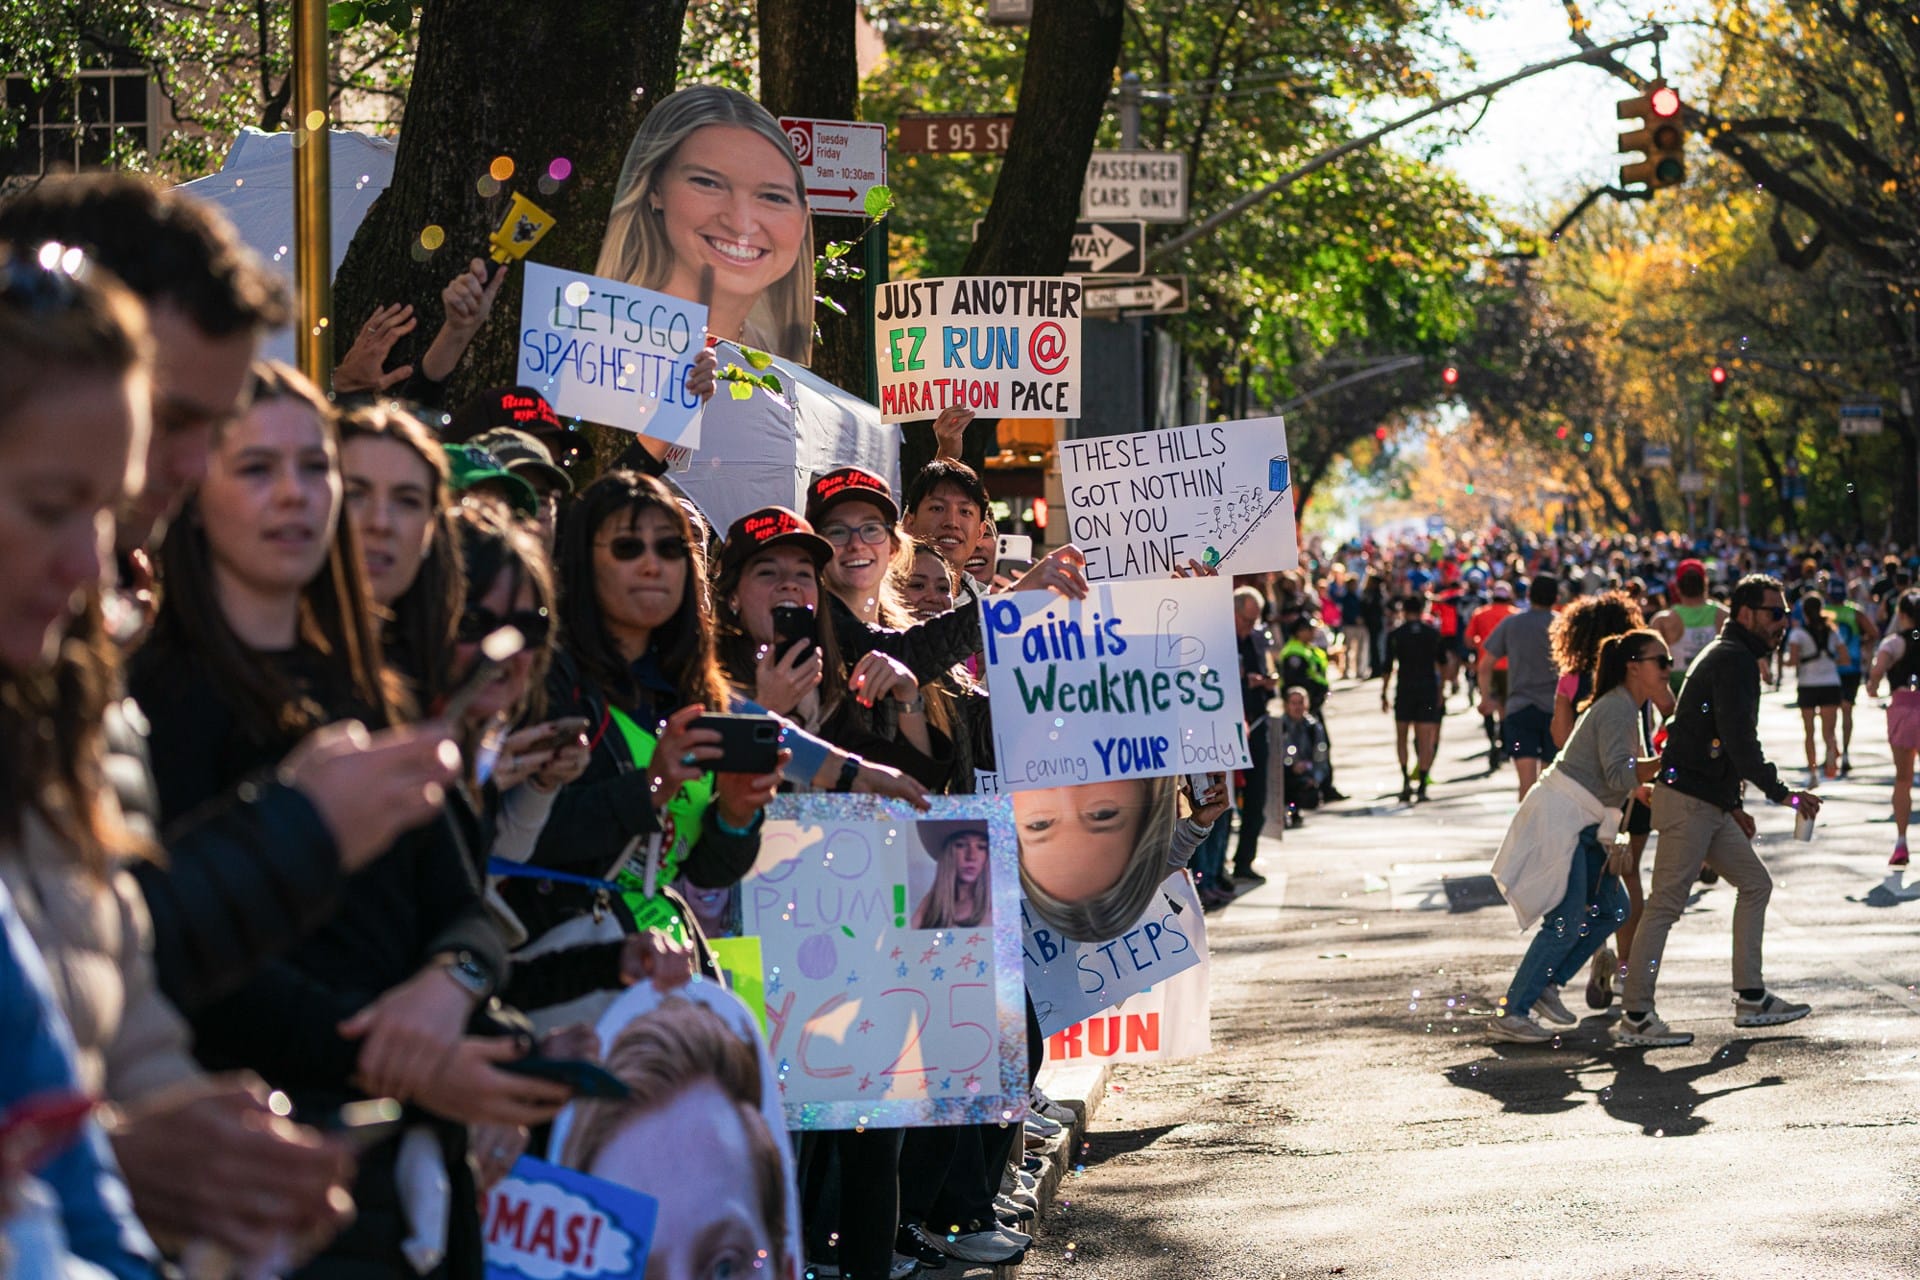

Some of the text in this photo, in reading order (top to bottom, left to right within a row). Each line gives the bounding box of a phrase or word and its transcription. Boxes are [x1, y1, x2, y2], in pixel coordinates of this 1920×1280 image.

[816, 132, 849, 148] Tuesday
[816, 146, 841, 160] Friday
[926, 122, 1010, 150] E 95 St
[816, 166, 834, 178] 9am
[841, 167, 875, 180] 10:30am
[1090, 160, 1179, 181] PASSENGER
[1090, 187, 1179, 208] CARS ONLY
[1071, 238, 1114, 258] WAY
[877, 280, 1081, 321] JUST ANOTHER
[889, 321, 1070, 375] EZ RUN @
[881, 378, 1069, 415] MARATHON PACE
[1064, 427, 1226, 472] THESE HILLS
[1071, 461, 1226, 507] GOT NOTHIN'
[1074, 506, 1167, 541] ON YOU
[1083, 534, 1192, 581] ELAINE
[982, 599, 1127, 665] Pain is
[1013, 662, 1224, 715] Weakness
[998, 721, 1248, 784] Leaving YOUR body!
[755, 828, 872, 883] GO
[753, 884, 907, 929] PLUM!
[1077, 913, 1189, 994] STEPS
[1050, 1012, 1160, 1061] RUN
[481, 1190, 602, 1270] MAS!
